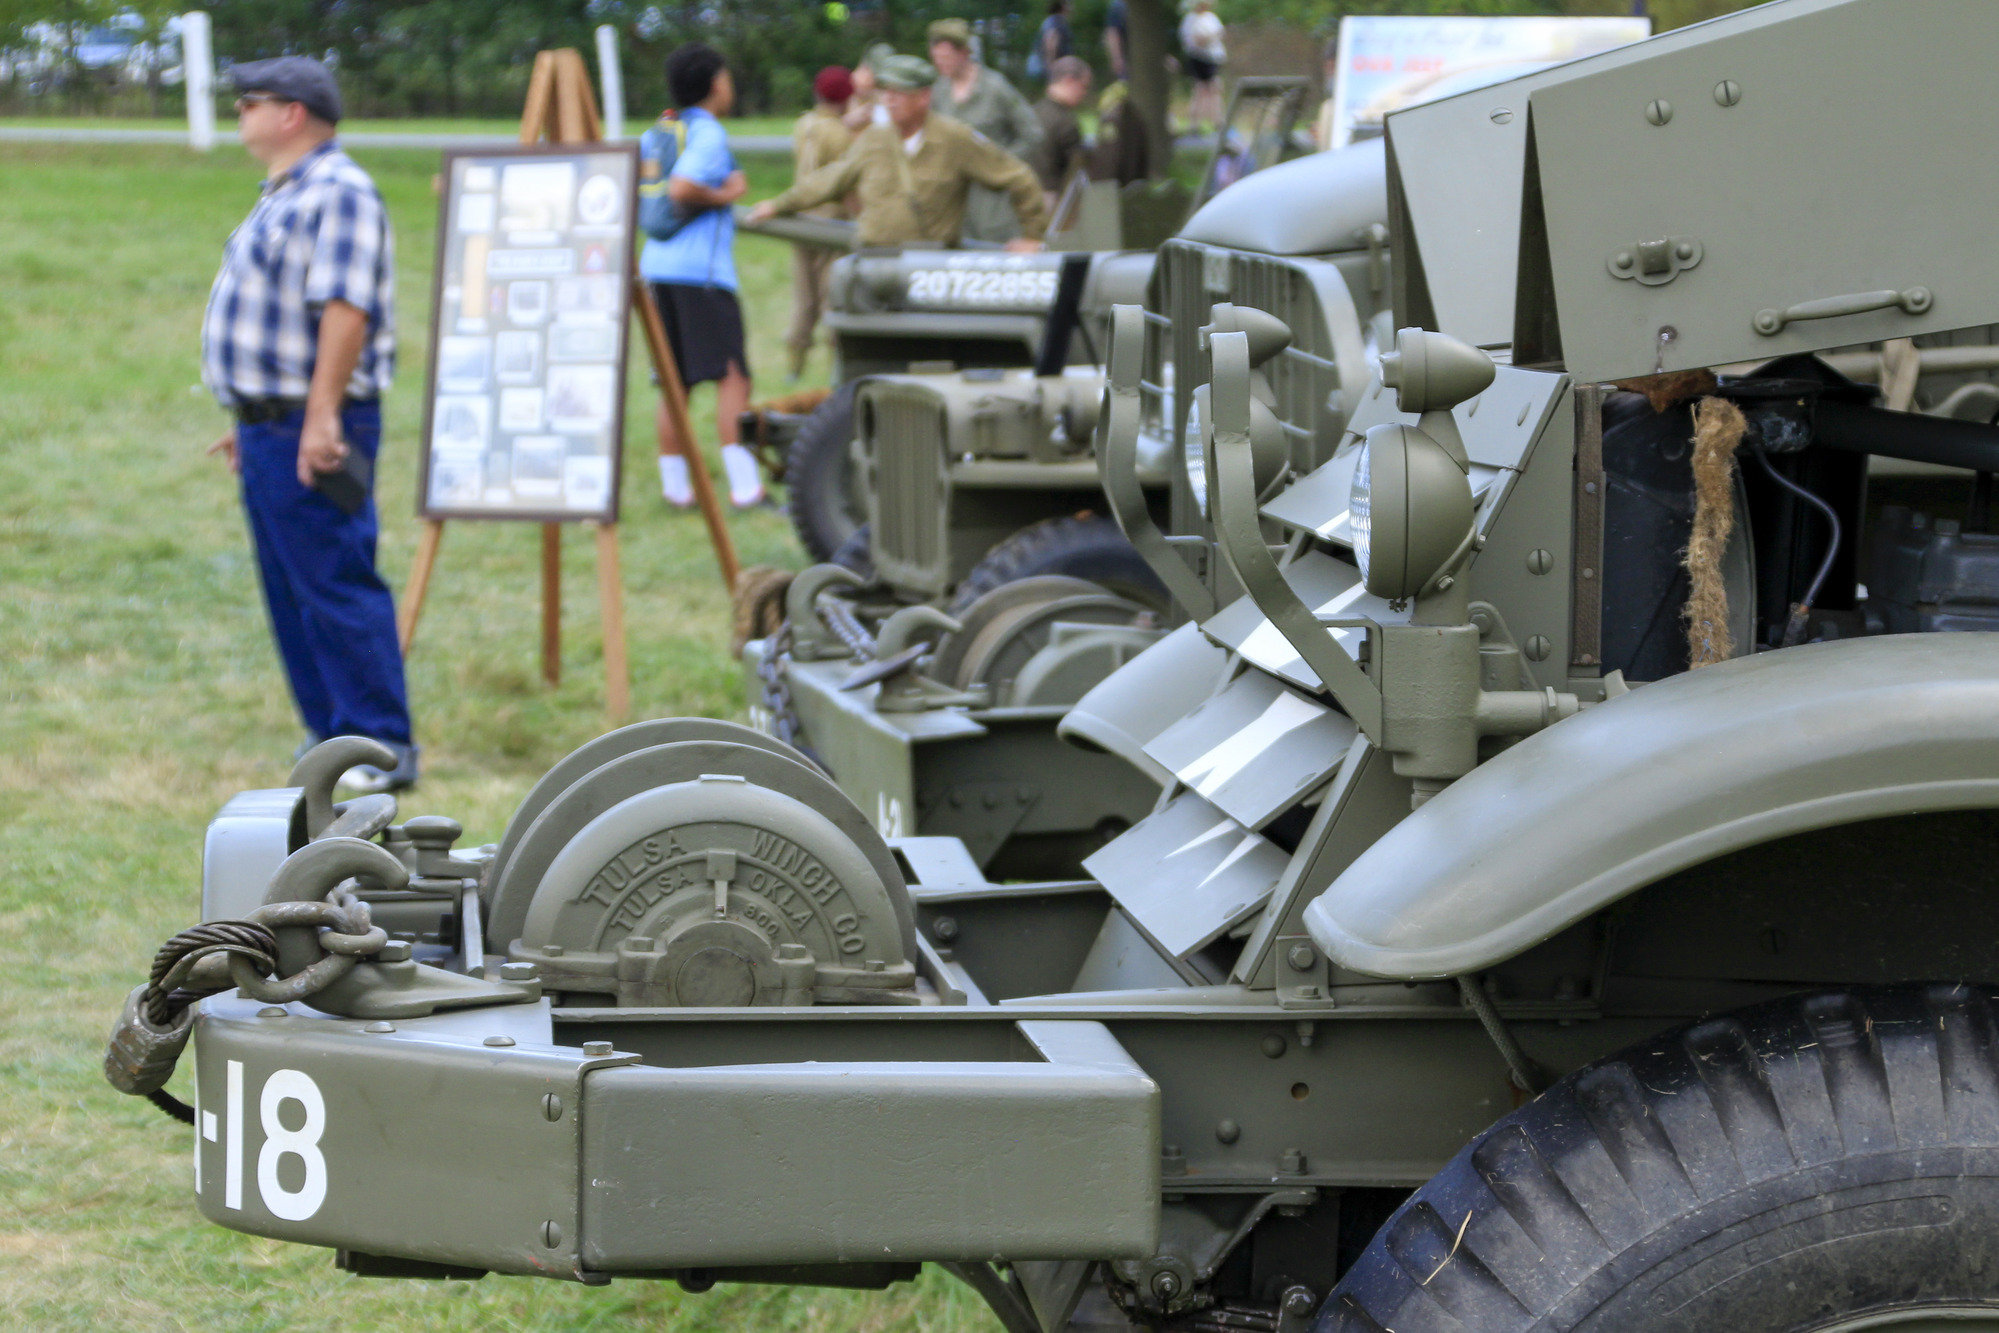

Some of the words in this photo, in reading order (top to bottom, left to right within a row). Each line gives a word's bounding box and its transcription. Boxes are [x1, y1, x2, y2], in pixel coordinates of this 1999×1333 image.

[581, 830, 688, 908] TULSA
[750, 829, 843, 906] WINCH
[833, 911, 868, 954] CO
[610, 866, 694, 932] TULSA
[747, 872, 816, 931] OKLA
[194, 1059, 327, 1222] -18
